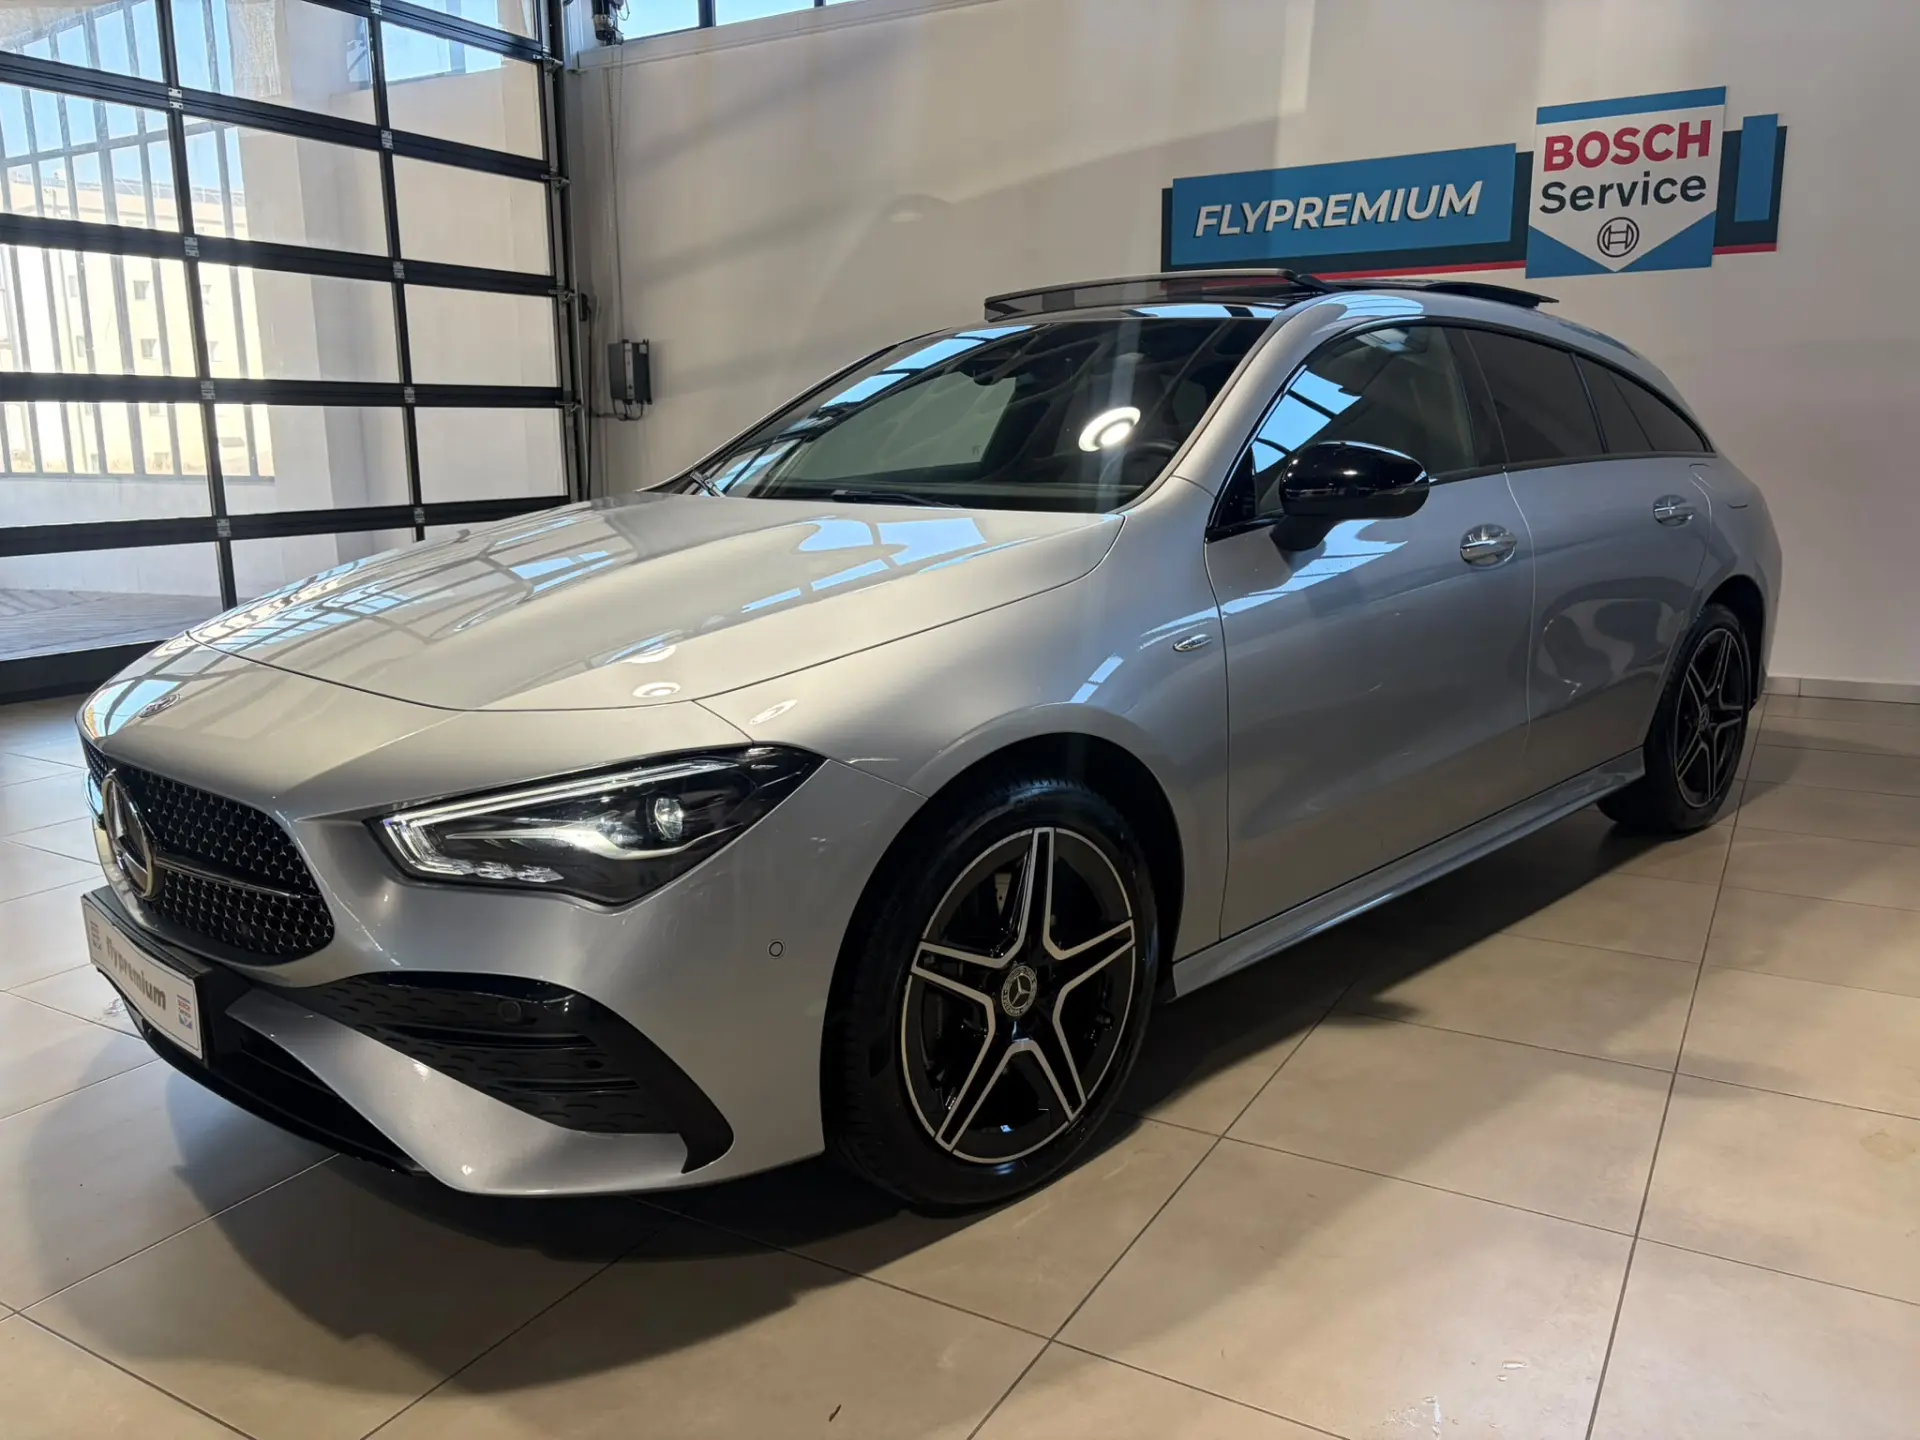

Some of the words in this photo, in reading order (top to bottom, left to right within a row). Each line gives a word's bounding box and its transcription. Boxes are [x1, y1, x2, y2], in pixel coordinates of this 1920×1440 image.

[1543, 119, 1712, 172] BOSCH
[1194, 180, 1483, 237] FLYPREMIUM
[1539, 170, 1707, 214] Service
